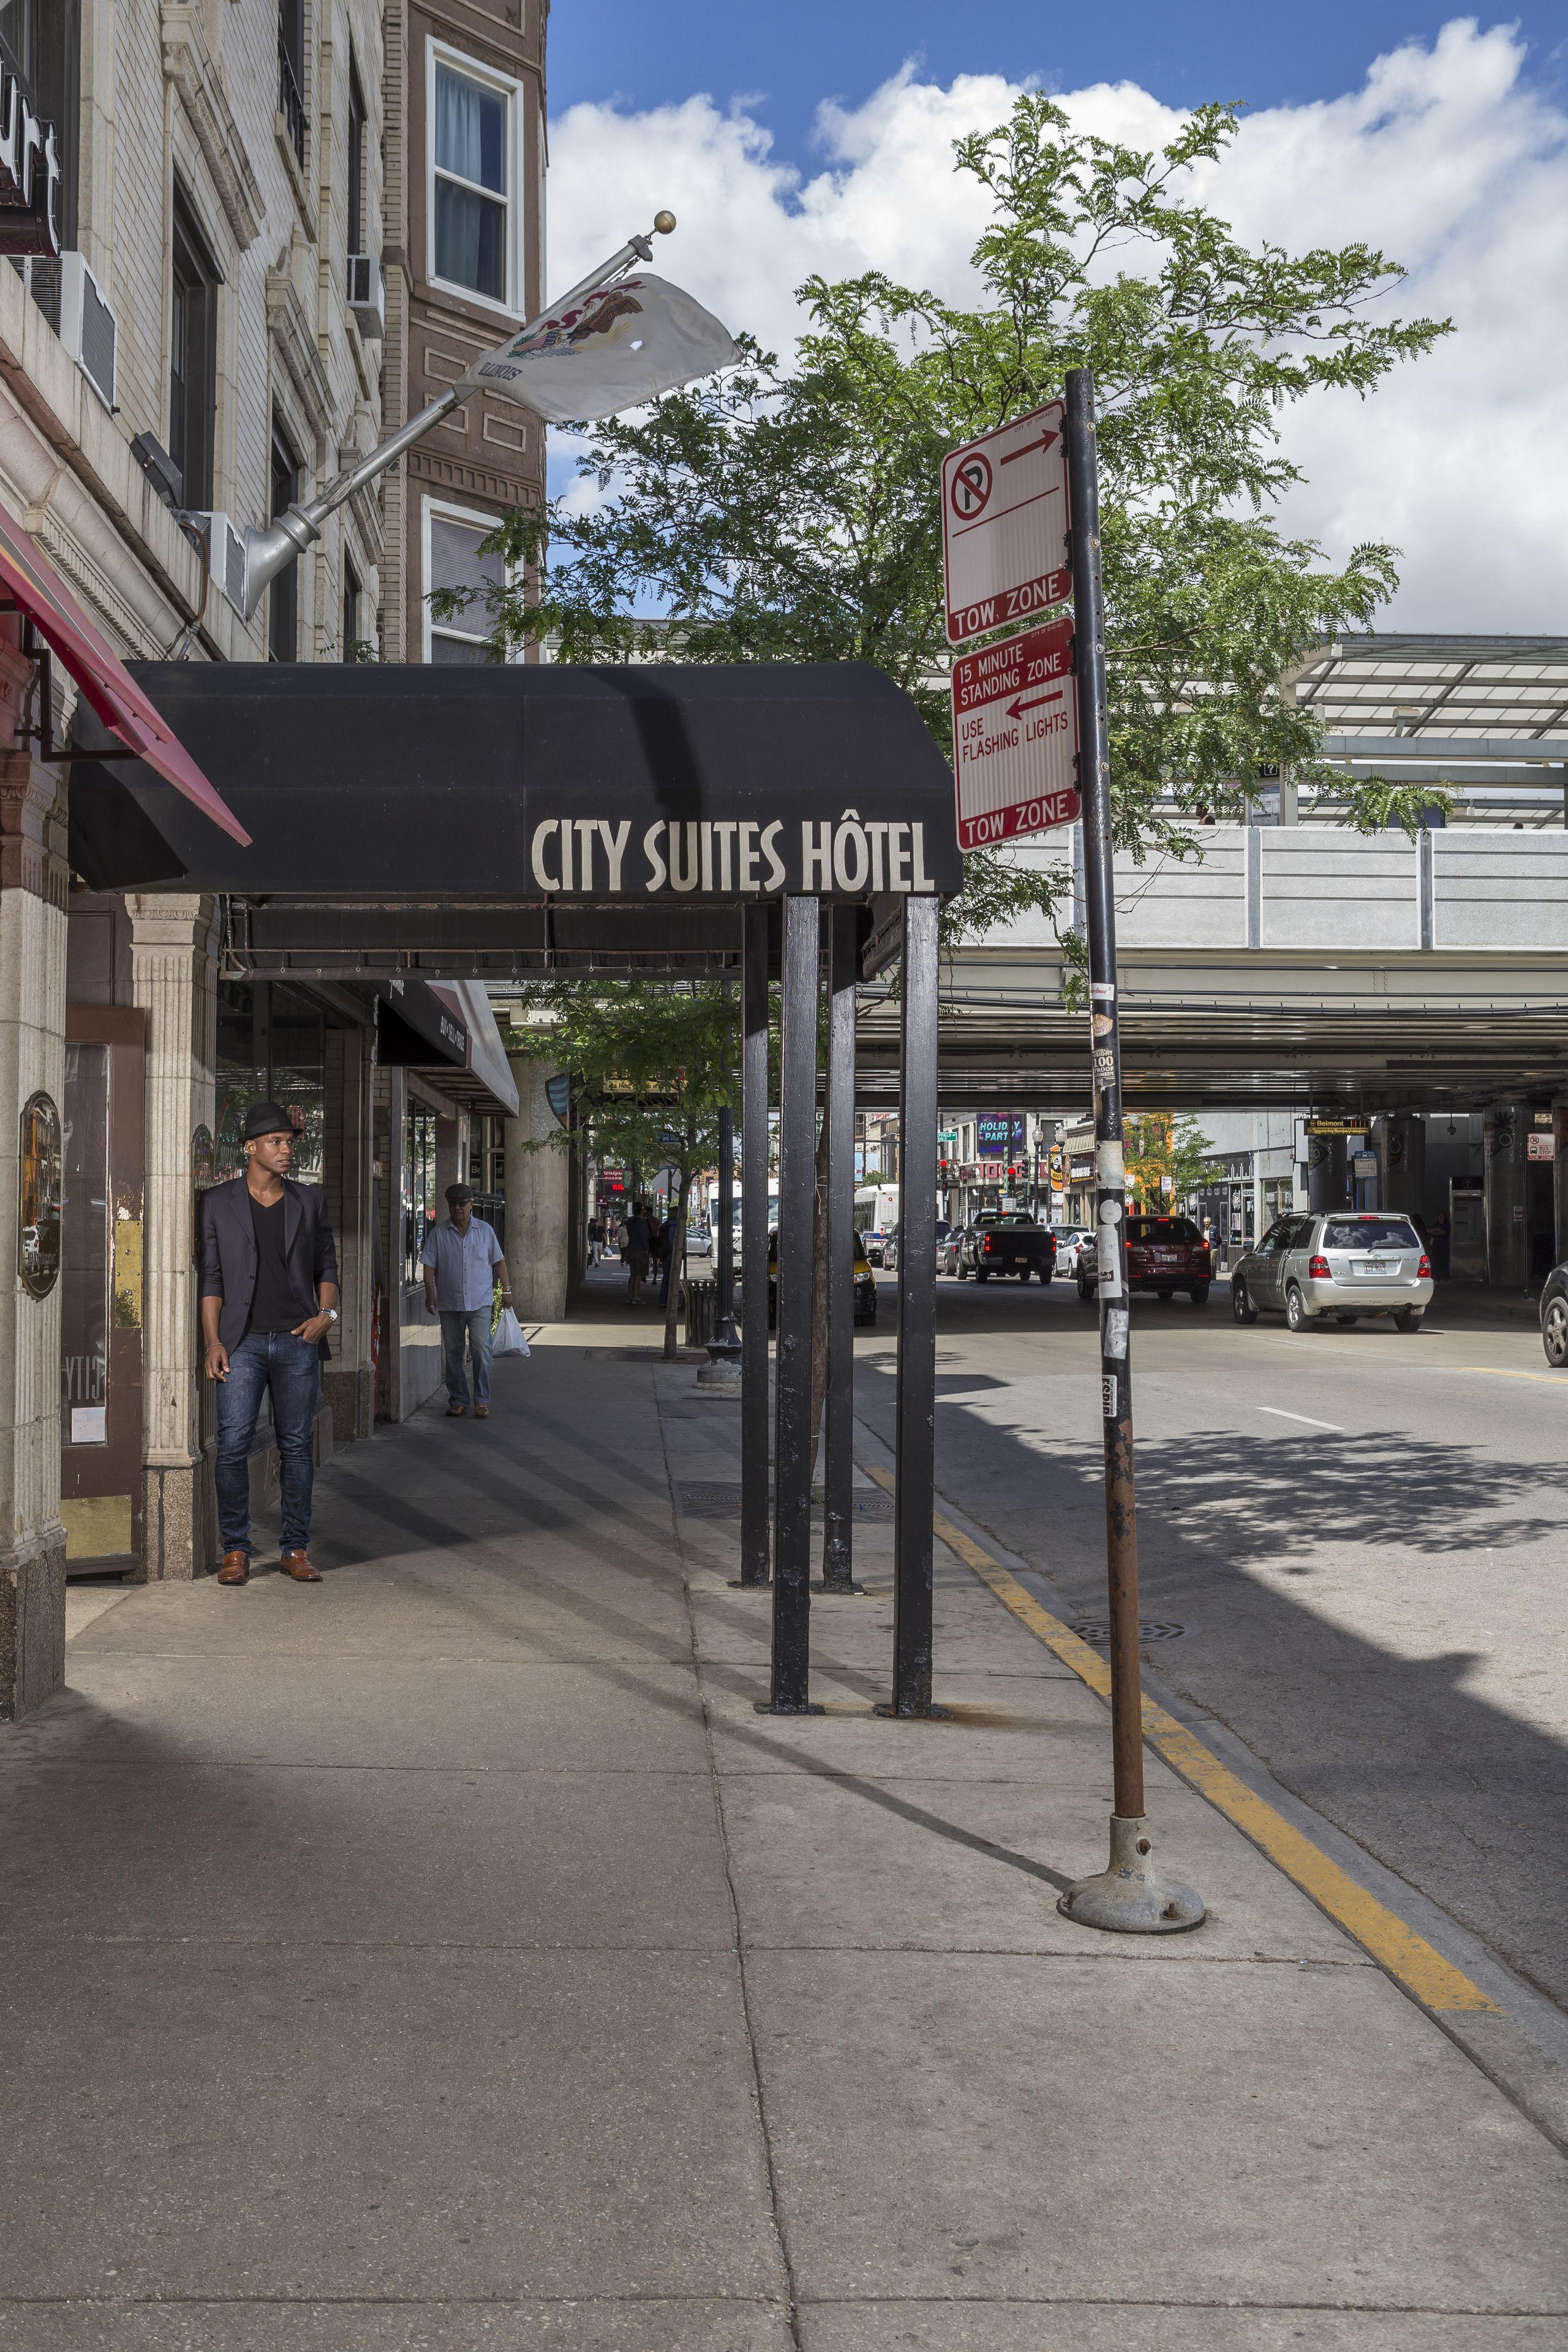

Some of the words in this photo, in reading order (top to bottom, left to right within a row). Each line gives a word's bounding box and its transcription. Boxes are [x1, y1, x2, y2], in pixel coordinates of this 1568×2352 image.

[477, 361, 522, 380] ILLINOIS
[1035, 410, 1054, 423] CHICAGO
[955, 601, 995, 635] TOW
[1007, 574, 1060, 616] ZONE
[1047, 621, 1065, 632] CHICAGO
[959, 663, 971, 684] 15
[979, 643, 1023, 677] MINUTE
[961, 668, 1020, 706] STANDING
[1027, 652, 1061, 682] ZONE
[962, 717, 984, 741] USE
[963, 729, 1019, 763] FLASHING
[1026, 711, 1068, 742] LIGHTS
[965, 812, 1004, 844] TOW
[1016, 794, 1069, 831] ZONE
[532, 819, 631, 891] CITY
[644, 819, 786, 892] SUITES
[802, 809, 935, 892] HÔTEL
[1093, 1056, 1114, 1068] 100
